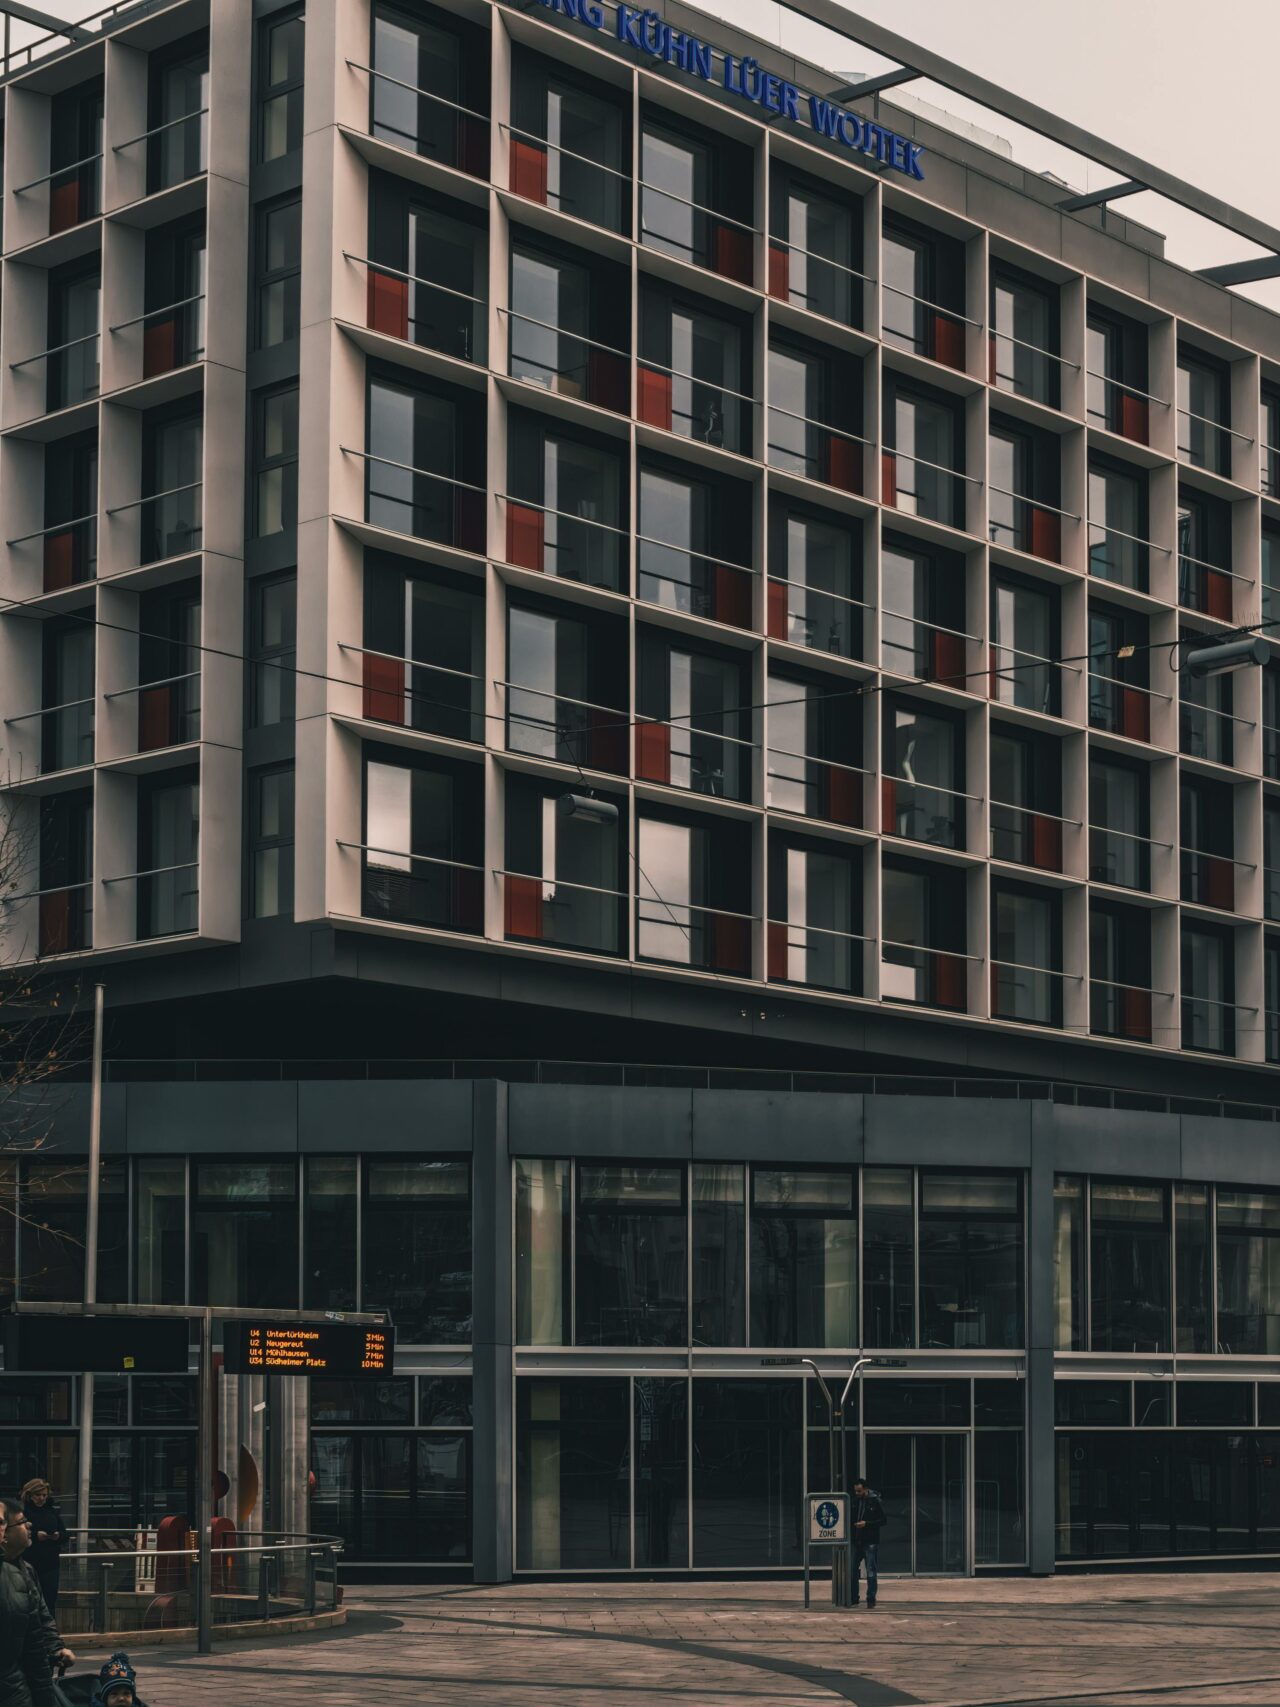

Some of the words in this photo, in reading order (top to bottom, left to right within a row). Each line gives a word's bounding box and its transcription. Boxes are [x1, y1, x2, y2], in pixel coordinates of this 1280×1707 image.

[616, 4, 713, 81] KÜHN
[724, 55, 800, 121] LÜER
[808, 95, 928, 181] WOJTEK
[250, 1329, 260, 1337] U4
[266, 1330, 319, 1339] Untertürkheim
[250, 1339, 260, 1347] U2
[266, 1339, 304, 1349] Neugereut
[249, 1348, 263, 1356] U14
[265, 1349, 309, 1357] Mühlhausen
[249, 1357, 263, 1365] U34
[265, 1357, 304, 1366] Südheimer
[305, 1358, 327, 1367] Platz
[818, 1529, 837, 1538] ZONE
